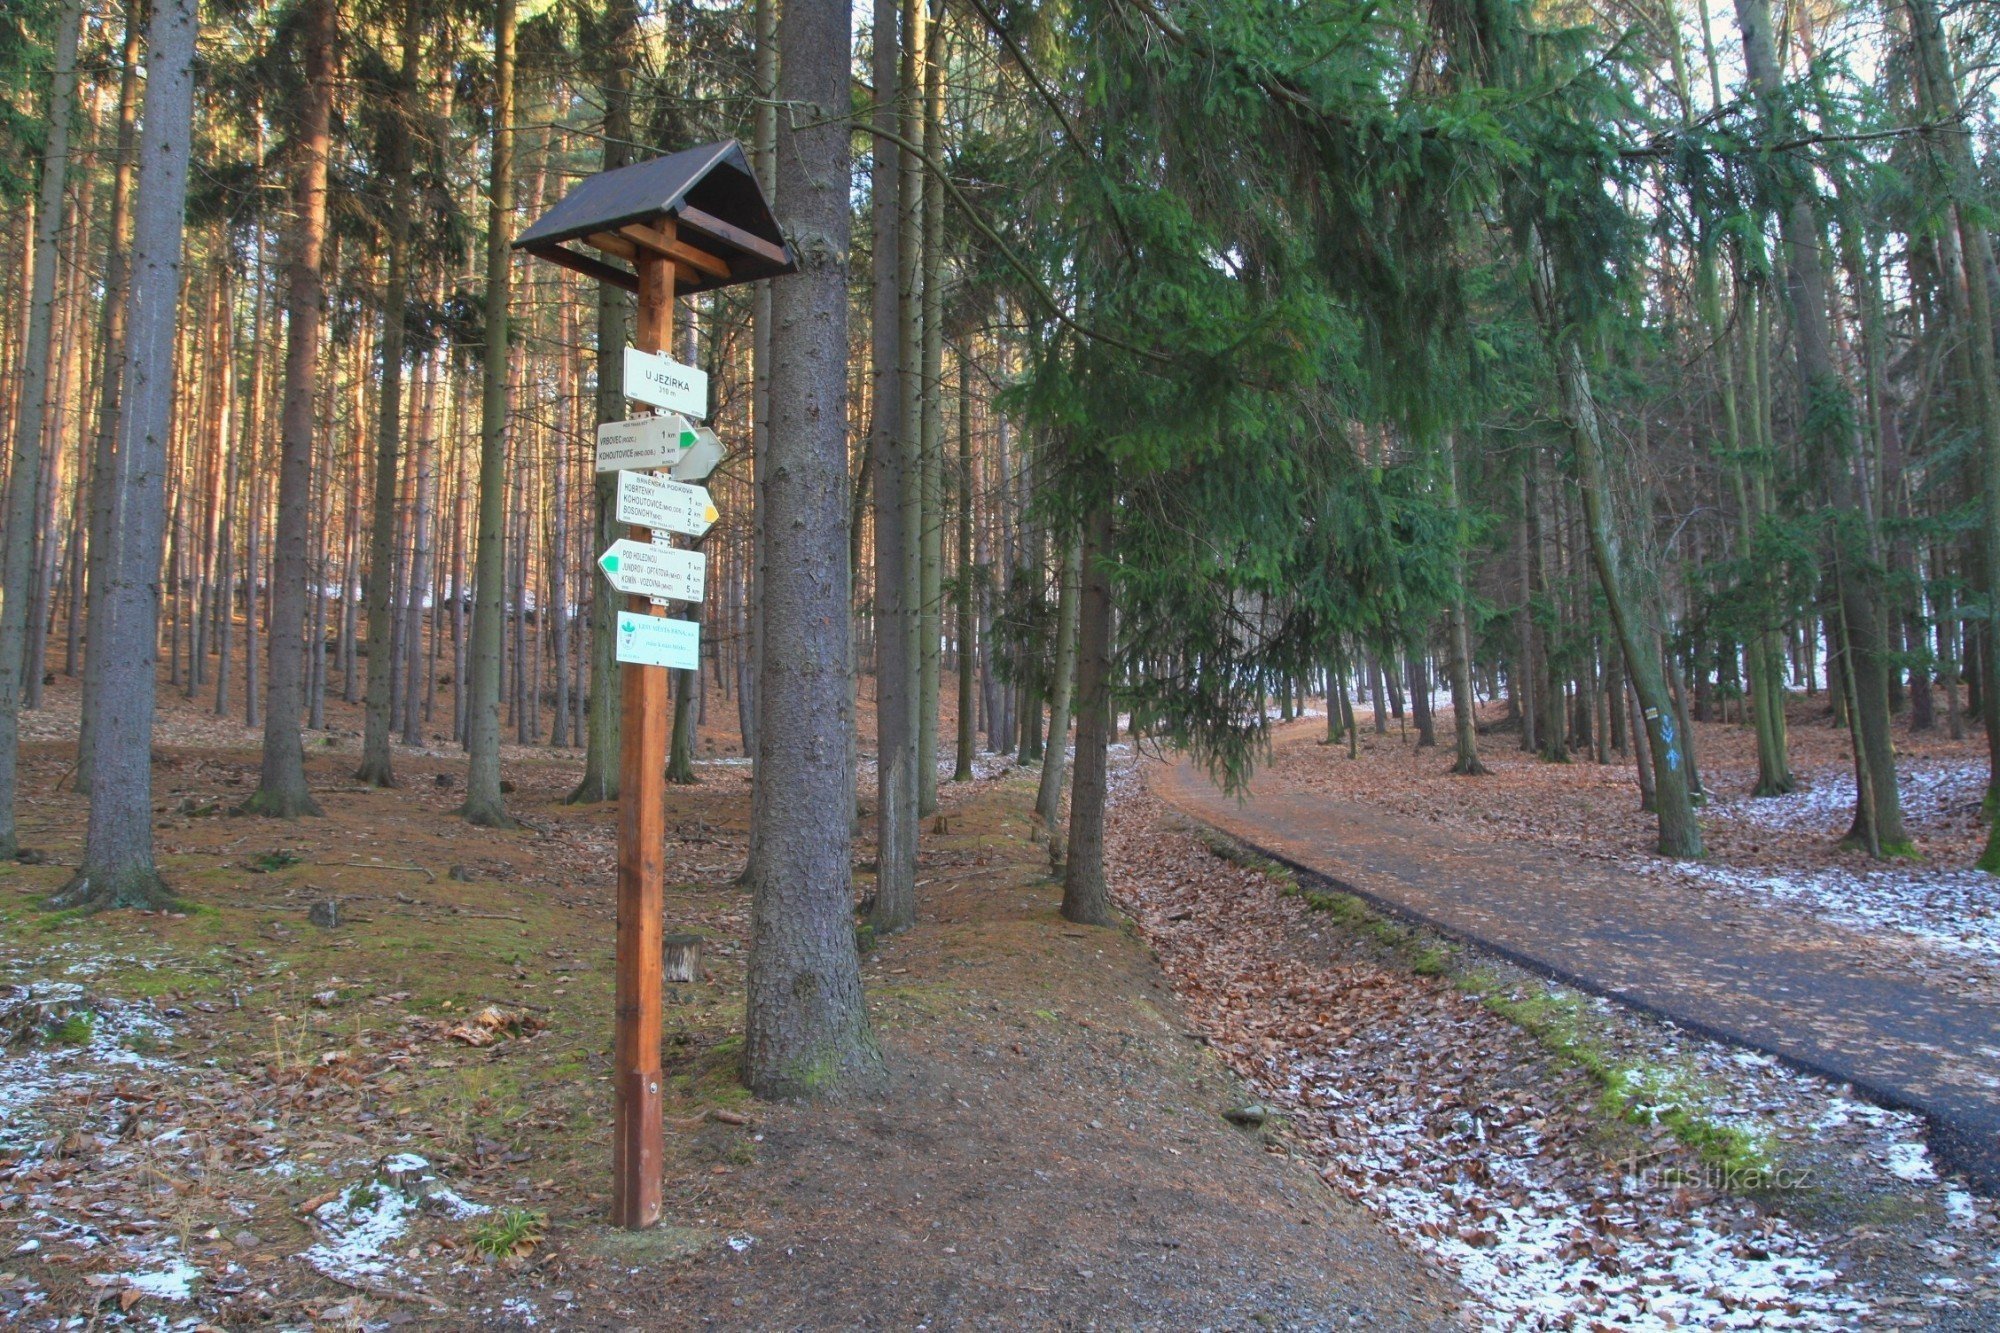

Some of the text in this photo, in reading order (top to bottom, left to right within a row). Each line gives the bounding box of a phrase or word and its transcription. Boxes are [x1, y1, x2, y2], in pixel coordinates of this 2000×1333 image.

[646, 370, 690, 392] U JEZÍRKA
[659, 386, 669, 395] 310
[662, 430, 666, 438] 1
[600, 436, 622, 446] VRBOVEC
[598, 449, 634, 460] KOHOUTOVICE
[661, 446, 666, 454] 3
[625, 484, 655, 496] HOBRTENKY
[637, 477, 693, 494] BRNĚNSKÁ PODKOVA
[624, 494, 662, 509] KOHOUTOVICE
[623, 505, 653, 518] BOSONOHY
[623, 550, 657, 564] POD HOLEDNOU
[622, 563, 643, 573] JUNDROV
[640, 577, 660, 588] VOZOVNA
